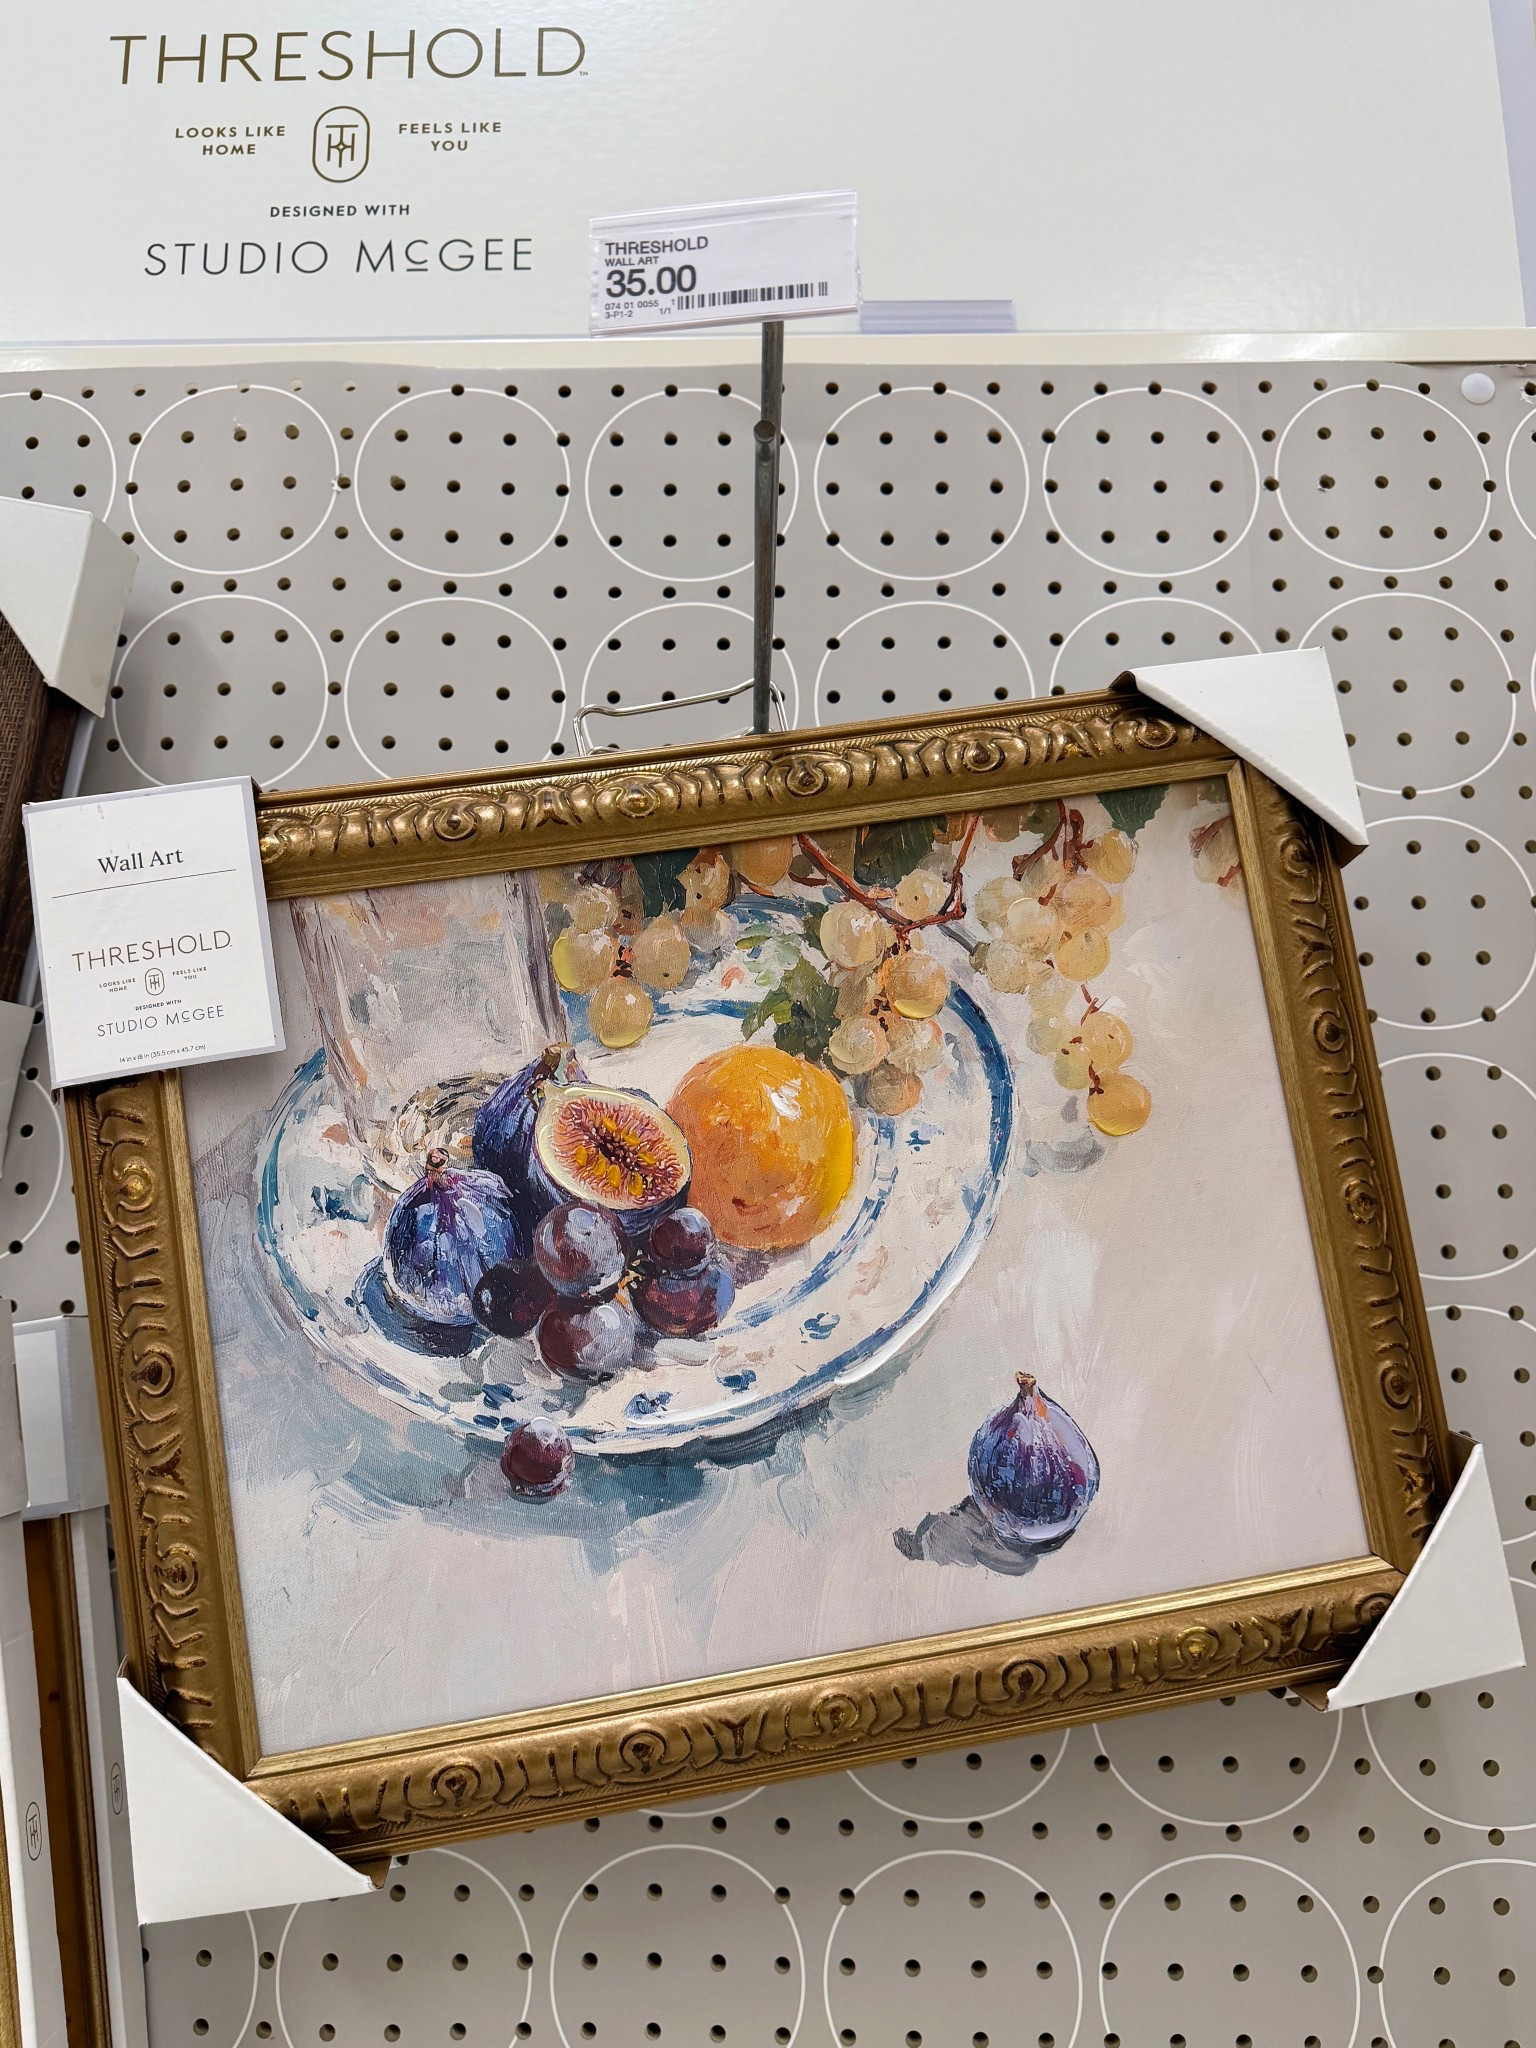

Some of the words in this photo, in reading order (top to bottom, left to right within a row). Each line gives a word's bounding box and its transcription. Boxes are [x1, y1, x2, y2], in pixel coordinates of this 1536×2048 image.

[175, 126, 238, 139] LOOKS
[245, 125, 286, 138] LIKE
[399, 122, 454, 135] FEELS
[461, 121, 503, 134] LIKE
[202, 143, 257, 156] HOME
[430, 139, 469, 153] YOU
[270, 204, 357, 218] DESIGNED
[364, 203, 410, 216] WITH
[605, 236, 709, 256] THRESHOLD
[143, 240, 329, 277] STUDIO
[605, 258, 635, 267] WALL
[637, 256, 659, 265] ART
[606, 264, 697, 298] 35.00
[637, 300, 659, 308] 0055
[659, 307, 671, 315] 1/1
[97, 852, 144, 874] Wall
[149, 849, 184, 867] Art
[135, 1002, 165, 1011] DESIGNED
[166, 999, 182, 1007] WITH
[97, 1016, 158, 1037] STUDIO
[151, 1050, 166, 1059] (35.5
